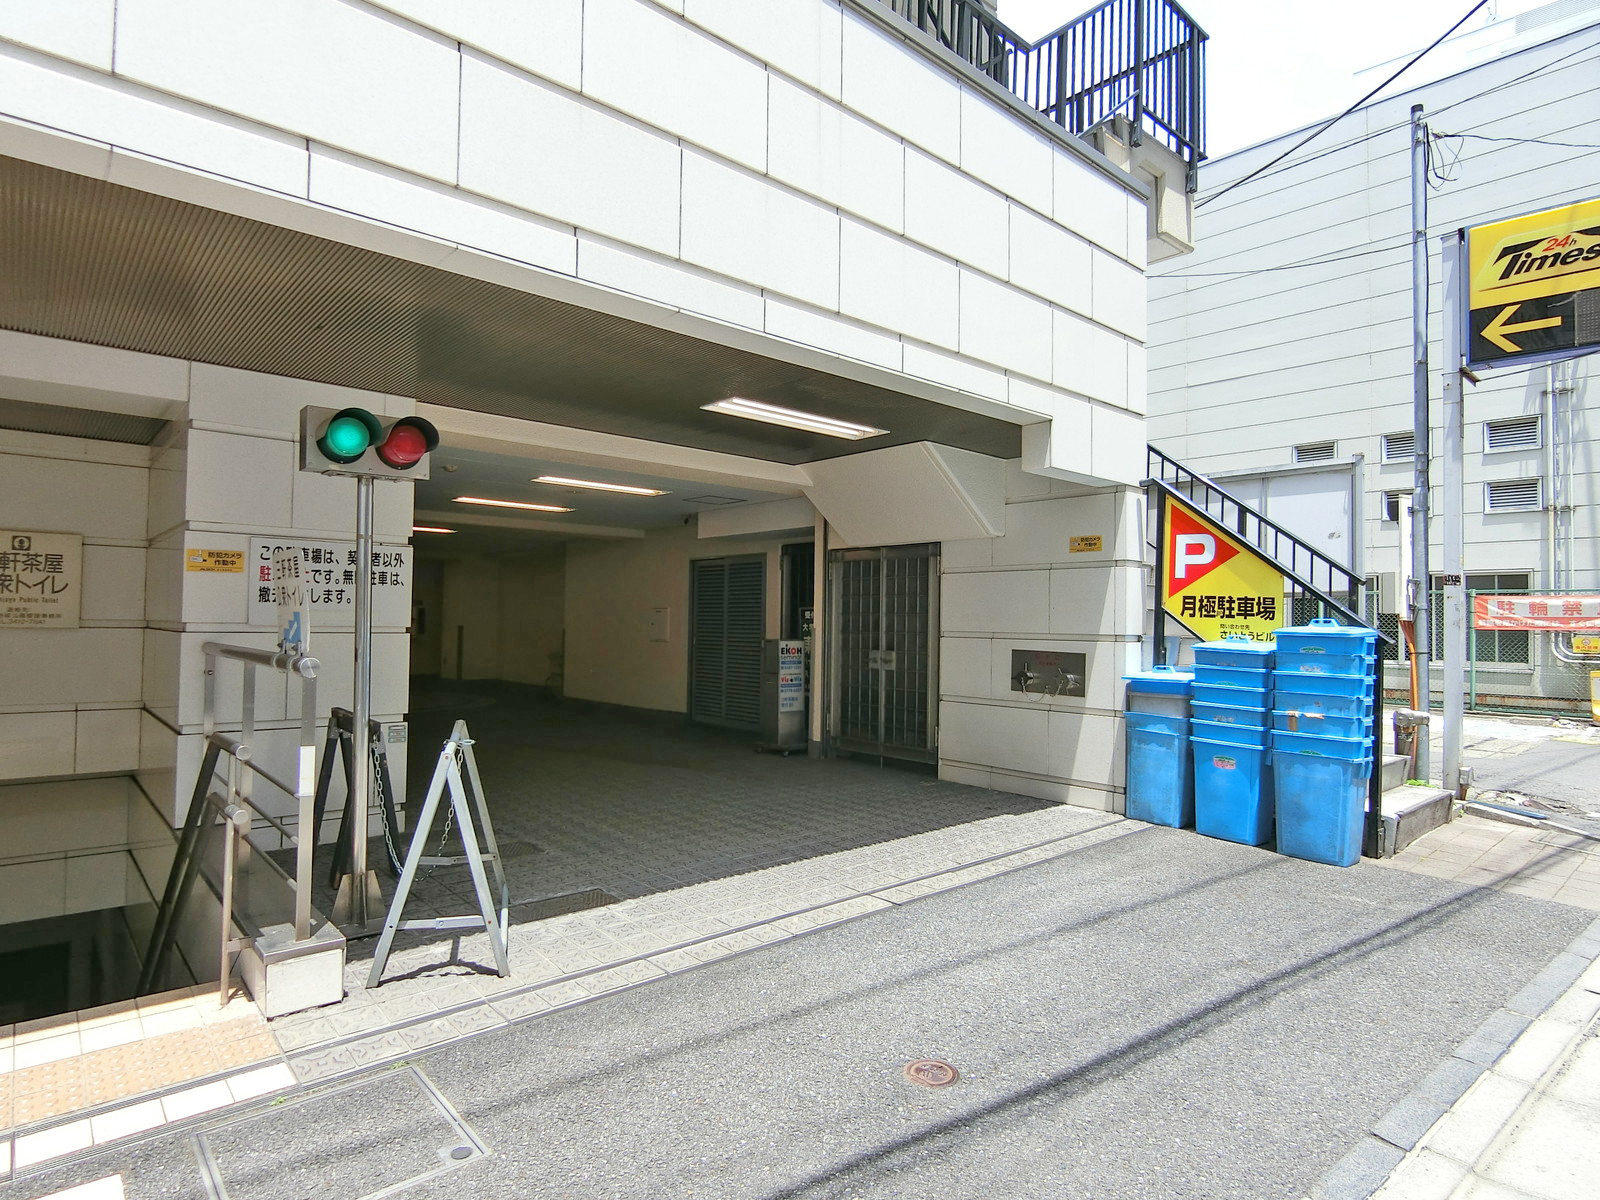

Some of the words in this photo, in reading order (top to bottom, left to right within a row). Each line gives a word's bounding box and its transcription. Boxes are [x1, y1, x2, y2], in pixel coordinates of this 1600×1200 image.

[1542, 235, 1577, 253] 24h
[1493, 236, 1600, 281] Times
[207, 551, 242, 560] 防犯カメラ
[214, 559, 237, 567] 作動中
[1174, 534, 1216, 579] P
[1180, 595, 1276, 621] 月極駐車場
[1496, 600, 1600, 616] 駐輪禁
